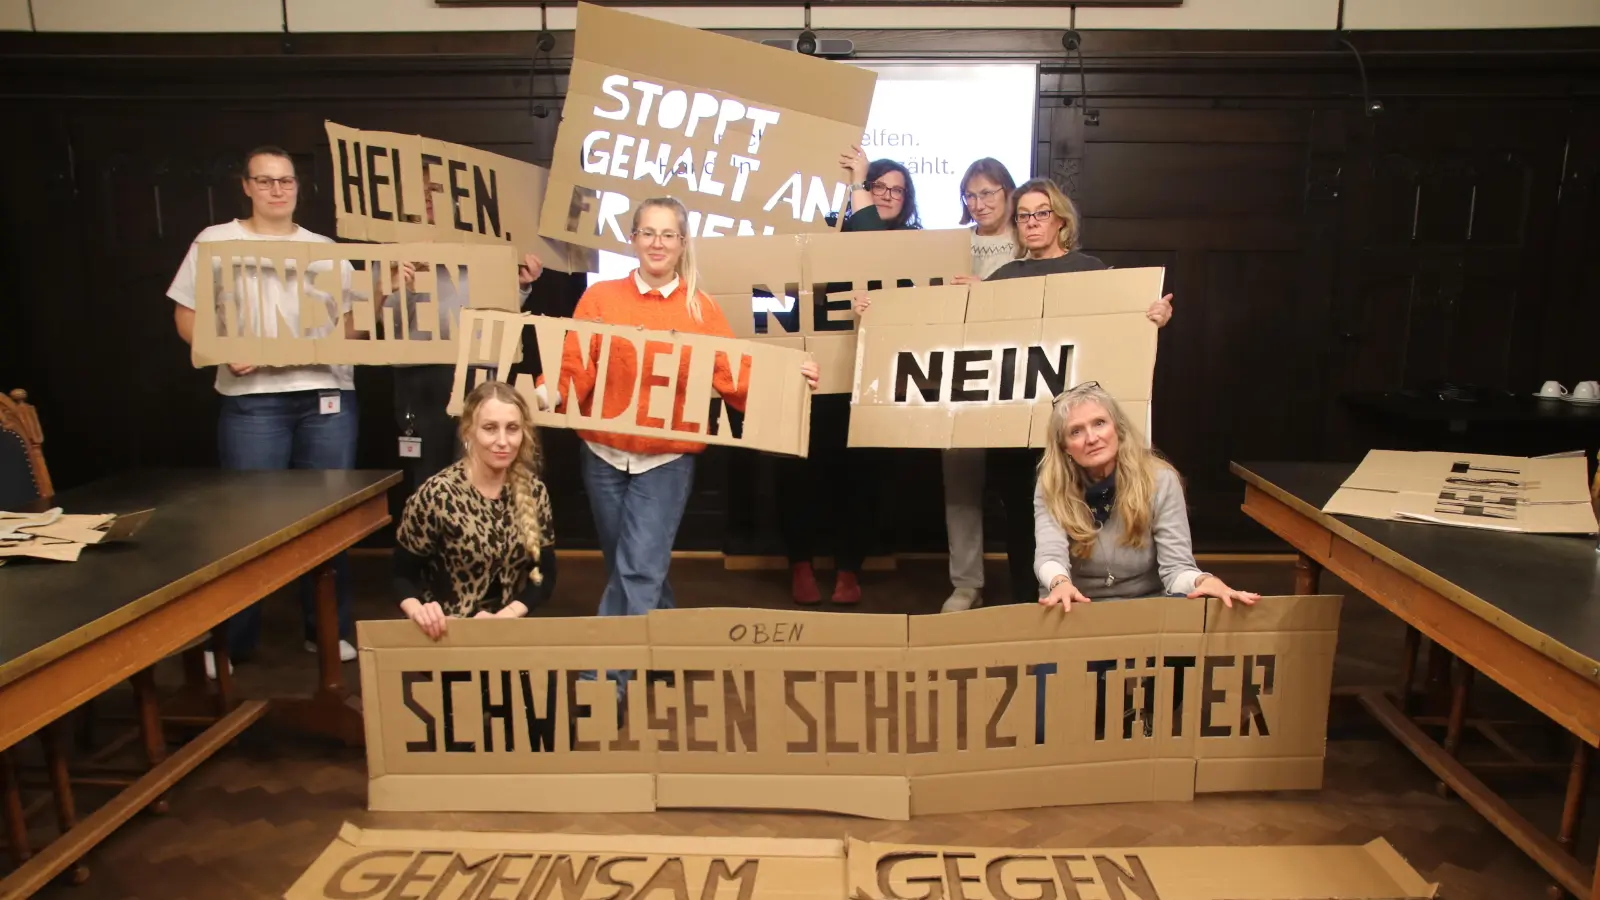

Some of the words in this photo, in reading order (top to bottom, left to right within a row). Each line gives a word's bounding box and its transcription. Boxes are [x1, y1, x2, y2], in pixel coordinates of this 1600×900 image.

[593, 74, 780, 154] STOPPT
[338, 138, 511, 241] HELFEN.
[580, 130, 760, 202] GEWALT
[763, 171, 848, 228] AN
[752, 277, 944, 334] NE
[464, 318, 752, 440] HANDELN
[894, 344, 1075, 403] NEIN
[728, 621, 804, 645] OBEN
[401, 668, 758, 754] SCHWEIGEN
[783, 661, 1059, 755] SCHÜTZT
[1086, 654, 1277, 742] TÄTER
[322, 849, 760, 900] GEMEINSAM
[875, 850, 1161, 900] GEGEN
